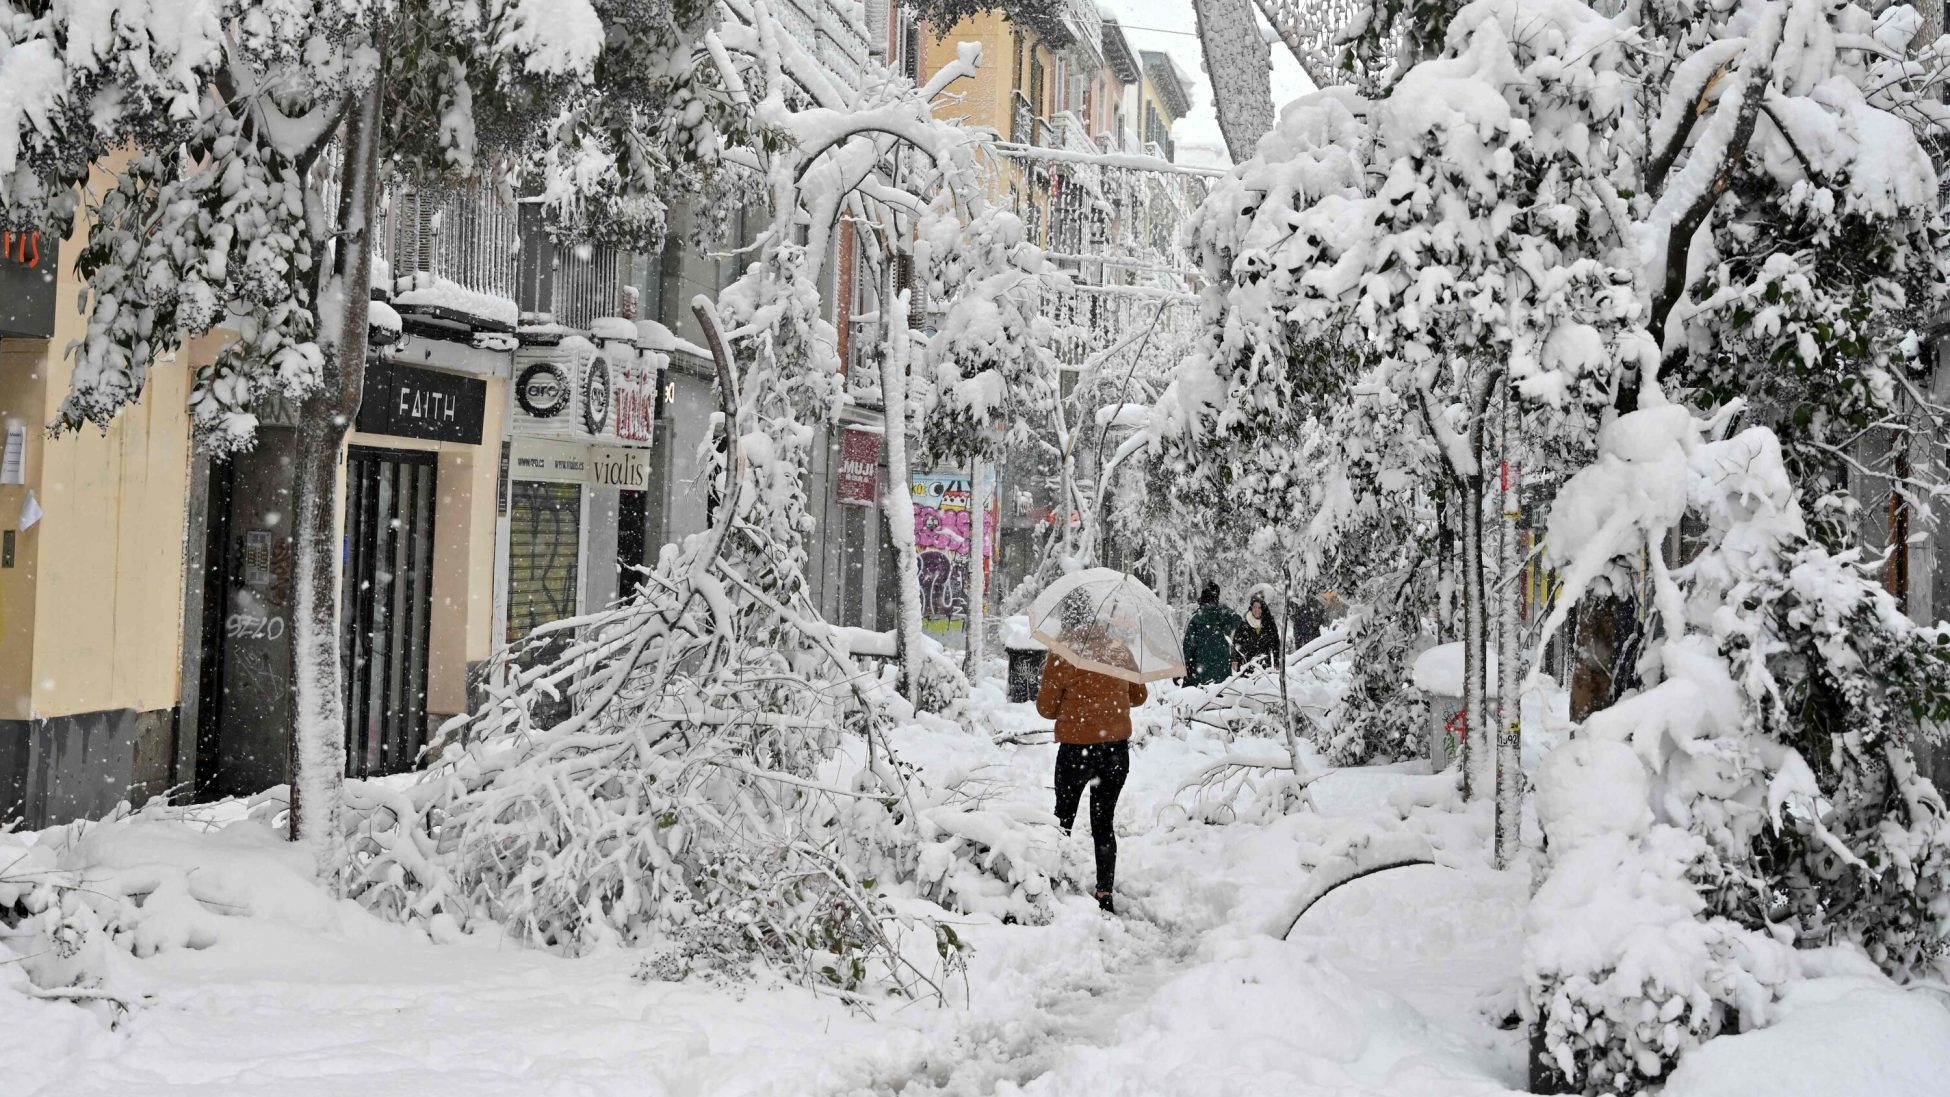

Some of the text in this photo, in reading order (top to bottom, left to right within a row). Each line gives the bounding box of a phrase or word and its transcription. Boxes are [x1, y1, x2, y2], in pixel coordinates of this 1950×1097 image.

[399, 387, 456, 422] FAITH
[595, 453, 643, 486] vialis
[843, 460, 874, 477] MUJI
